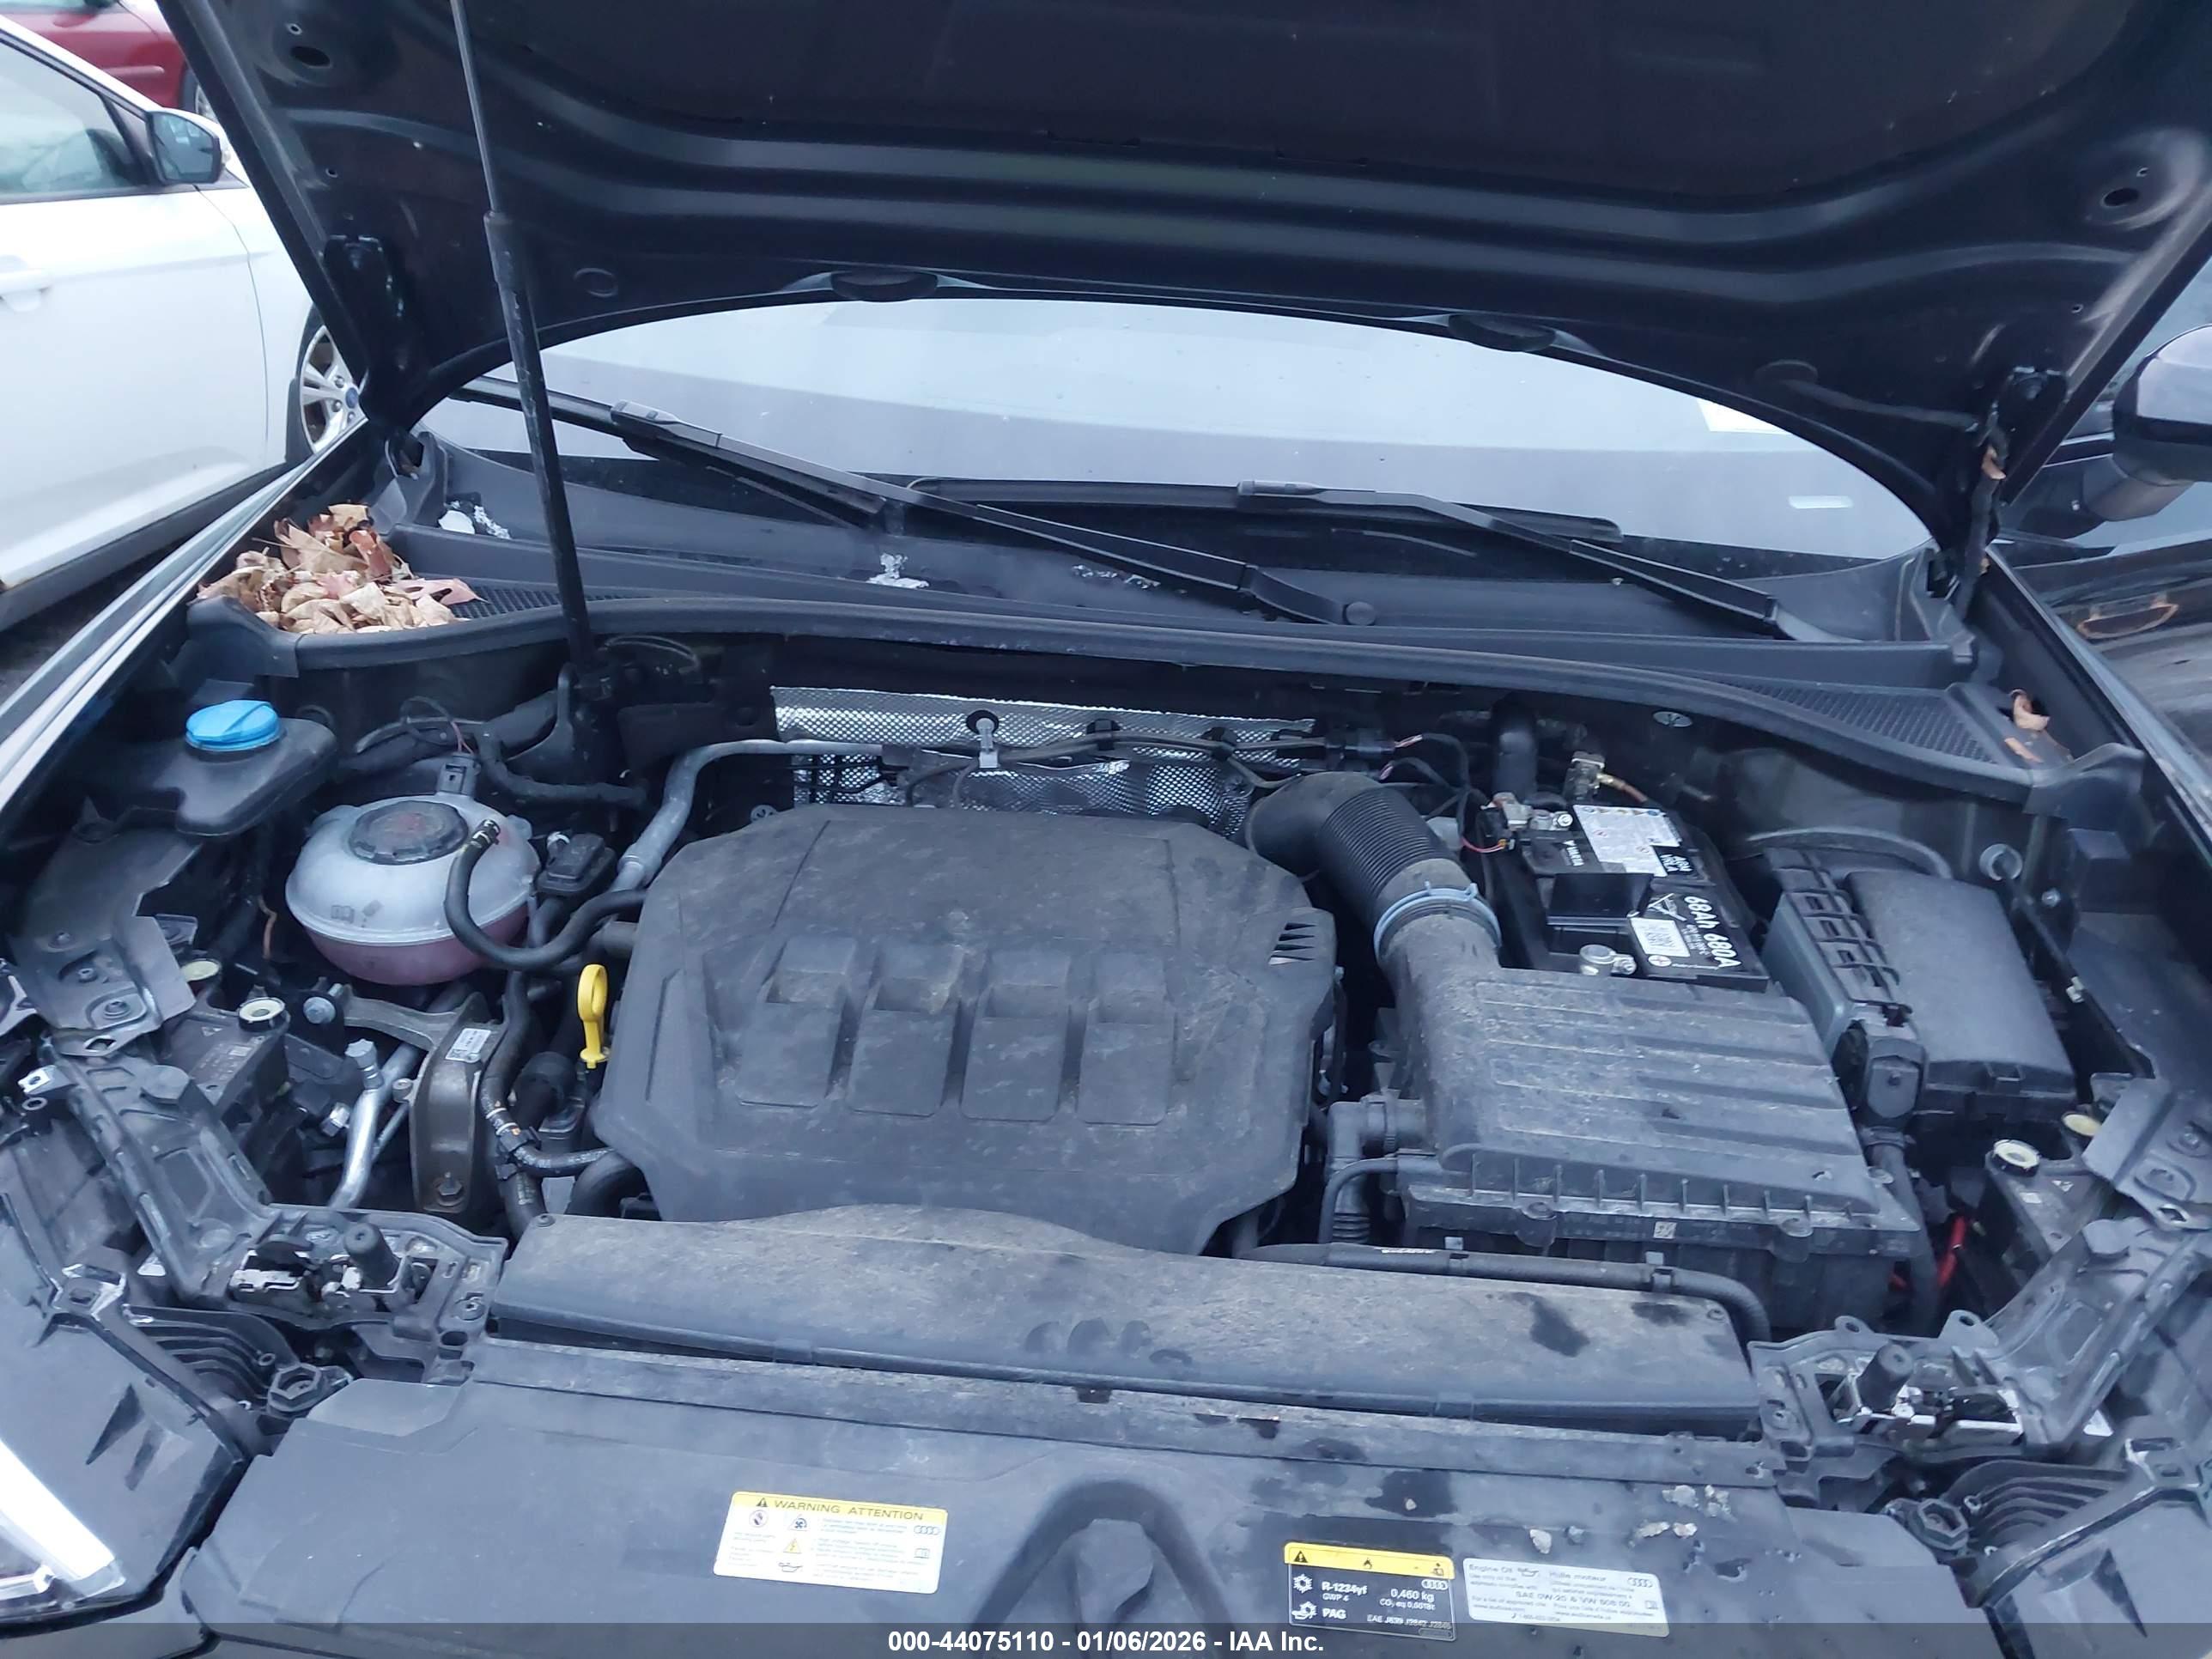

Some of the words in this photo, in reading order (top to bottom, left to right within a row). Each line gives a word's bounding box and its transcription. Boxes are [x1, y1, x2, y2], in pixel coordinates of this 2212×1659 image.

[1684, 896, 1721, 929] 68Ah
[1703, 933, 1741, 968] 680A
[774, 1499, 841, 1514] WARNING
[848, 1507, 924, 1522] ATTENTION
[1469, 1564, 1498, 1573] Engine
[1322, 1581, 1368, 1595] R-1234yf
[1390, 1589, 1419, 1601] 0,460
[1421, 1591, 1435, 1603] kg
[1322, 1608, 1346, 1620] PAG
